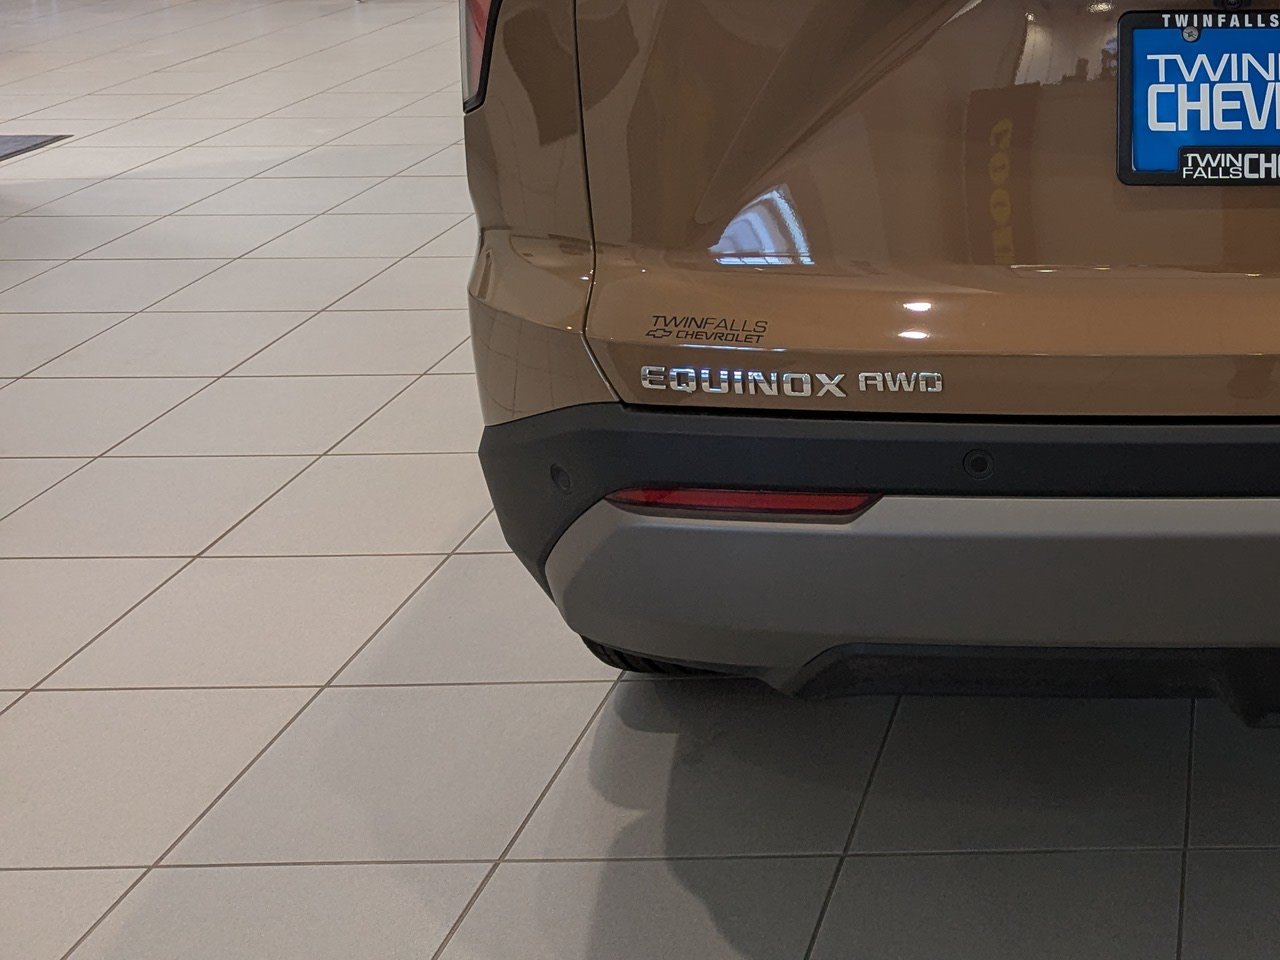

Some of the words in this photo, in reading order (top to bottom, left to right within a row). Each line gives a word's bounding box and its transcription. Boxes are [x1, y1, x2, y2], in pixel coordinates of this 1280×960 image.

[1184, 153, 1242, 167] TWIN
[1183, 167, 1242, 179] FALLS
[652, 315, 768, 334] TWINFALLS
[676, 330, 764, 343] CHEVROLET
[640, 365, 846, 398] EQUINOX
[858, 372, 942, 392] AWD
